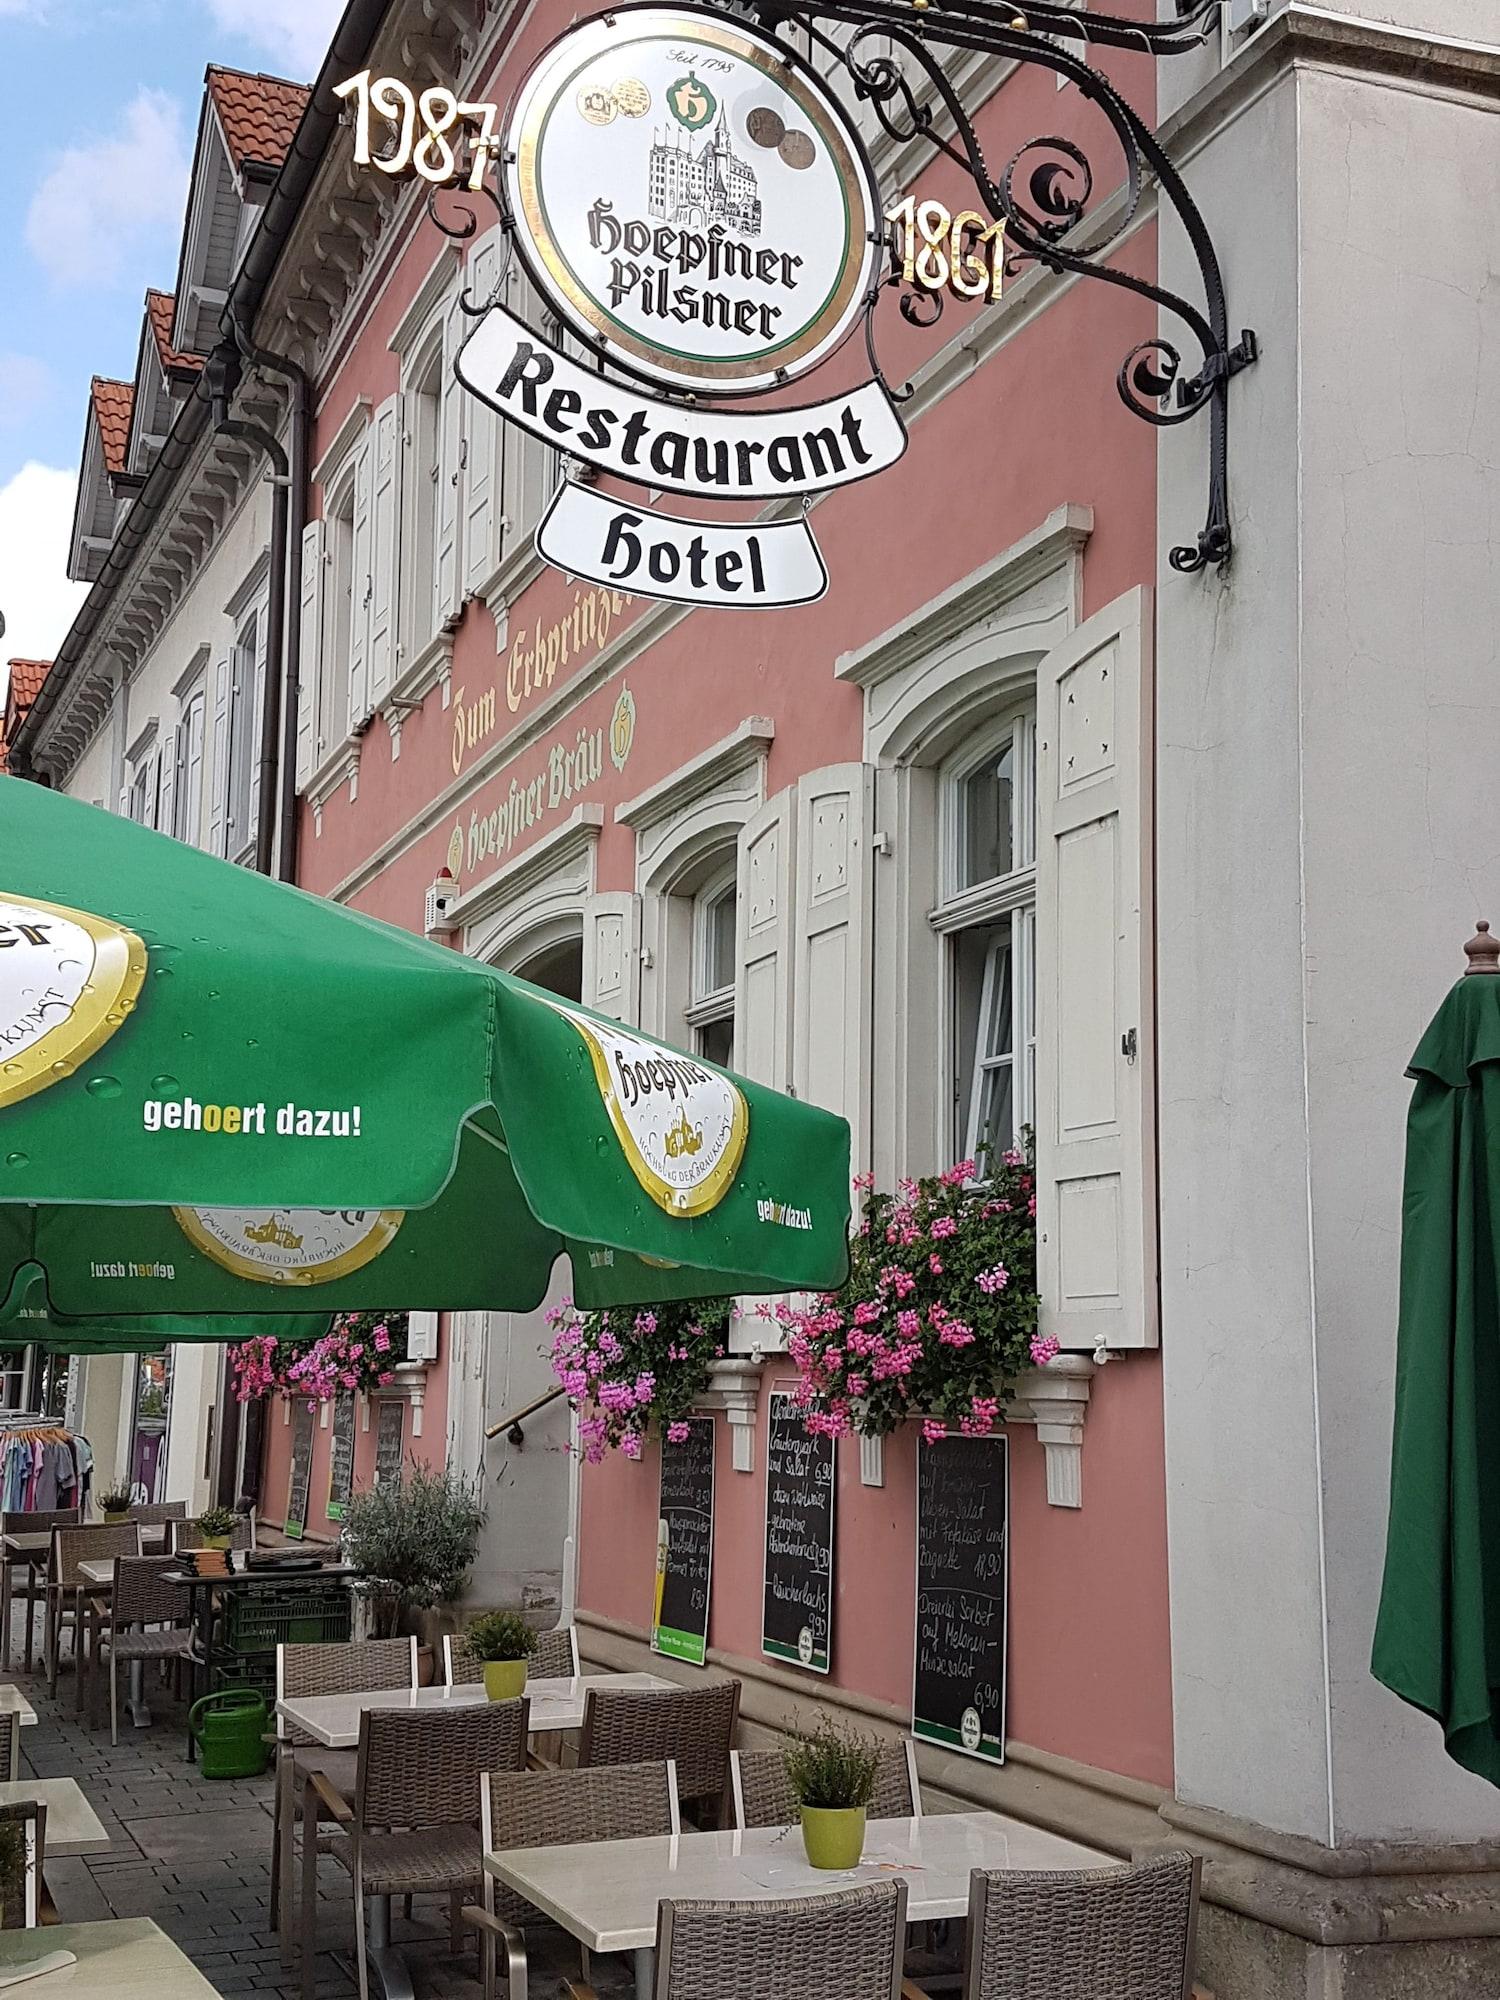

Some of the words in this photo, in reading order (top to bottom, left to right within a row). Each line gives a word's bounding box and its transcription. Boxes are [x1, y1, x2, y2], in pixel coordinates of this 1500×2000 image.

[665, 47, 696, 65] Seit
[332, 68, 497, 192] 1987
[587, 197, 804, 290] Hoepfner
[883, 195, 1009, 301] 1861
[606, 257, 783, 341] Pilsner
[495, 341, 873, 486] Restaurant
[600, 512, 766, 593] Hotel
[452, 685, 497, 776] Zum
[467, 773, 547, 873] Hoepfner
[547, 727, 603, 809] Bräu
[143, 1097, 267, 1135] gehoert
[276, 1103, 362, 1137] dazu!
[615, 1049, 713, 1108] Hoepfner
[959, 1595, 996, 1627] Sorbet
